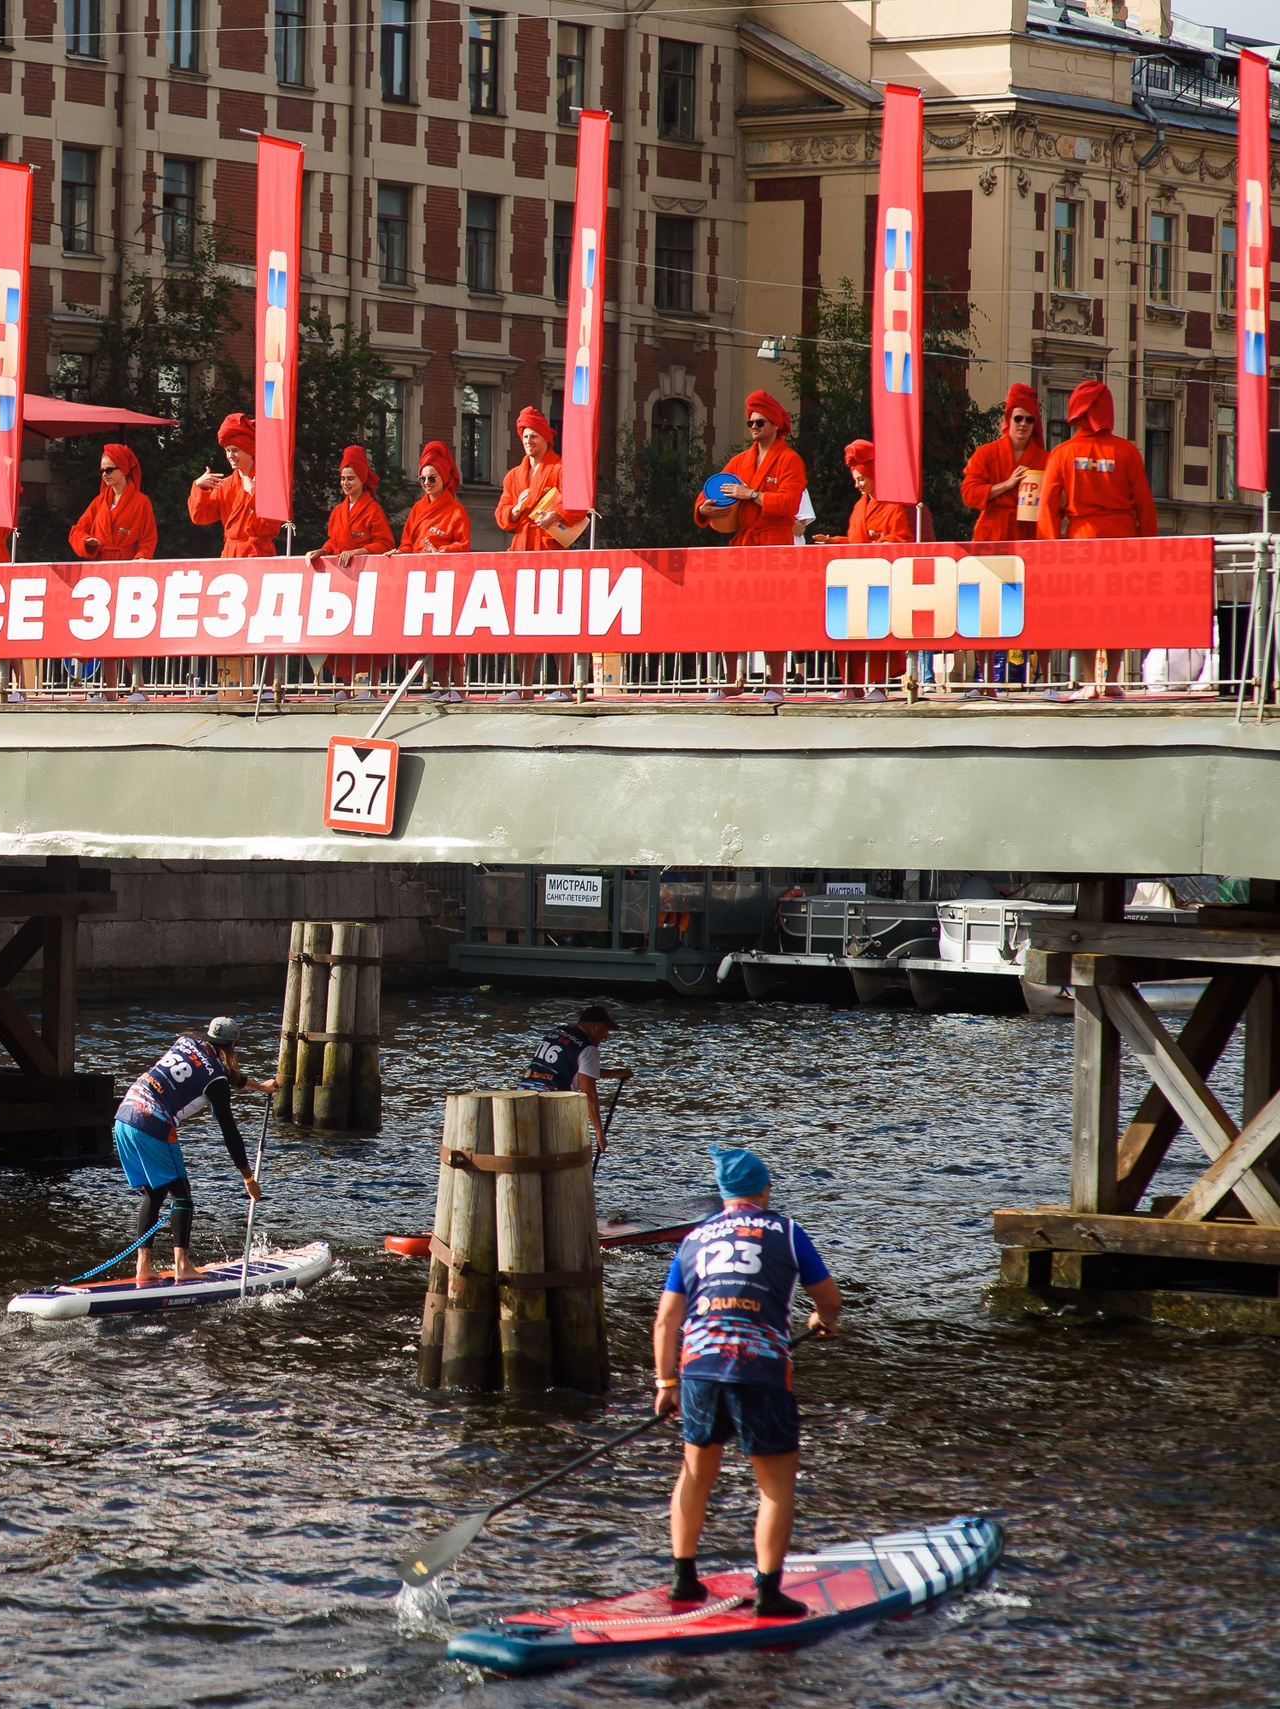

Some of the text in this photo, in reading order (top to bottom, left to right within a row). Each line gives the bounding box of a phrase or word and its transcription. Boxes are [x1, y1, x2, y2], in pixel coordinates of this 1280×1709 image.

[883, 207, 913, 394] ТНТ
[68, 569, 379, 643] ЗВЁЗДЫ
[402, 566, 643, 637] НАШИ
[825, 554, 1026, 640] ТНТ
[333, 770, 386, 815] 2.7
[546, 893, 601, 903] САНКТ-ПЕТЕРБУРГ
[548, 879, 599, 892] МИСТРАЛЬ
[695, 1240, 763, 1279] 123
